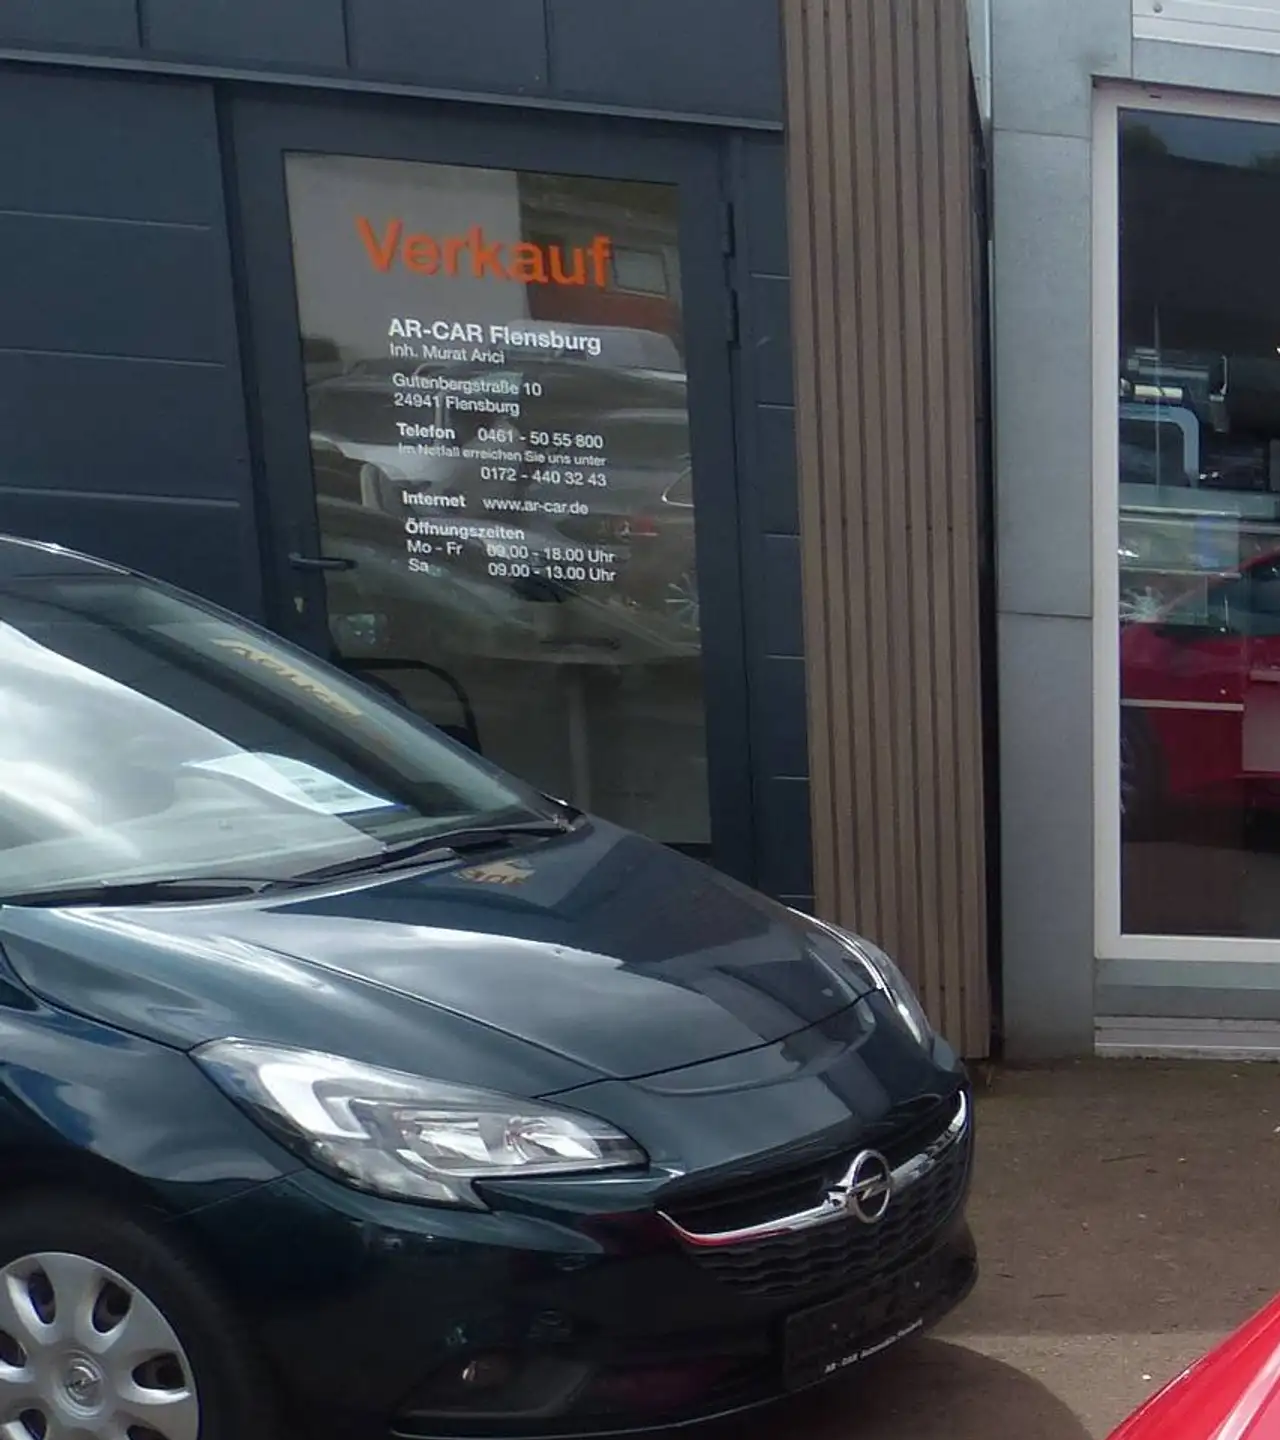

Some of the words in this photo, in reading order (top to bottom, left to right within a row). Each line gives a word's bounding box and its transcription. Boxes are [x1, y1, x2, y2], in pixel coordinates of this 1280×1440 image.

[356, 214, 614, 288] Verkauf
[387, 318, 484, 343] AR-CAR
[489, 325, 602, 355] Flensburg
[389, 342, 418, 357] Inh.
[422, 344, 468, 361] Murat
[392, 373, 519, 395] Gutenbergstraße
[523, 382, 543, 396] 10
[394, 392, 440, 408] 24941
[445, 396, 520, 417] Flensburg
[396, 421, 456, 440] Telefon
[477, 427, 514, 443] 0461
[530, 431, 549, 446] 50
[552, 433, 572, 447] 55
[575, 434, 604, 449] 800
[462, 447, 522, 462] erreichen
[523, 450, 546, 464] Sie
[547, 453, 572, 465] uns
[573, 455, 607, 467] unter
[480, 466, 517, 481] 0172
[531, 469, 561, 485] 440
[564, 471, 585, 486] 32
[587, 473, 607, 487] 43
[402, 490, 467, 508] Internet
[482, 498, 589, 515] www.ar-car.de
[405, 517, 525, 540] Öffnungszeiten
[406, 539, 432, 554] Mo
[446, 541, 464, 556] Fr
[545, 547, 585, 562] 18.00
[588, 549, 616, 564] Uhr
[408, 558, 429, 572] Sa
[487, 562, 530, 578] 09.00
[545, 564, 586, 580] 13.00
[589, 567, 617, 582] Uhr
